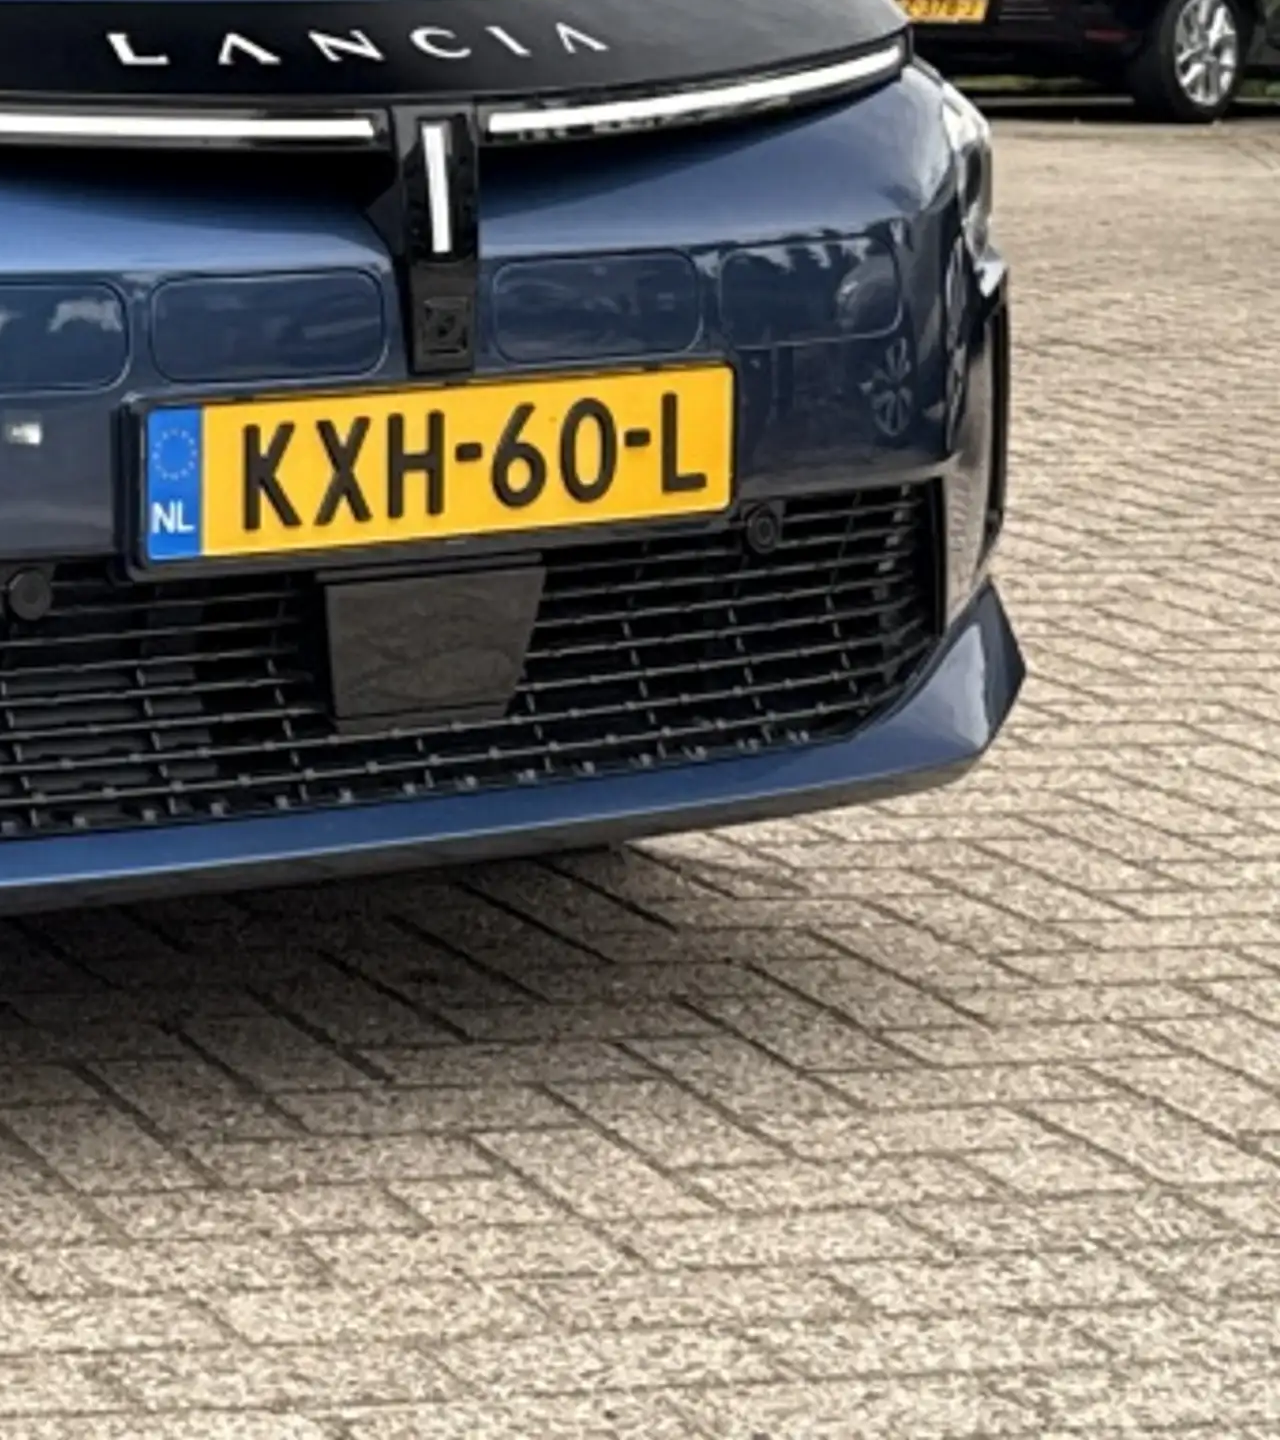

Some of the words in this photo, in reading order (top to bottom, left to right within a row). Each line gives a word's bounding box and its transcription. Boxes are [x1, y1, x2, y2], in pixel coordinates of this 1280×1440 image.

[106, 21, 610, 66] LANCIA
[242, 392, 707, 531] KXH-60-L
[151, 501, 194, 534] NL
